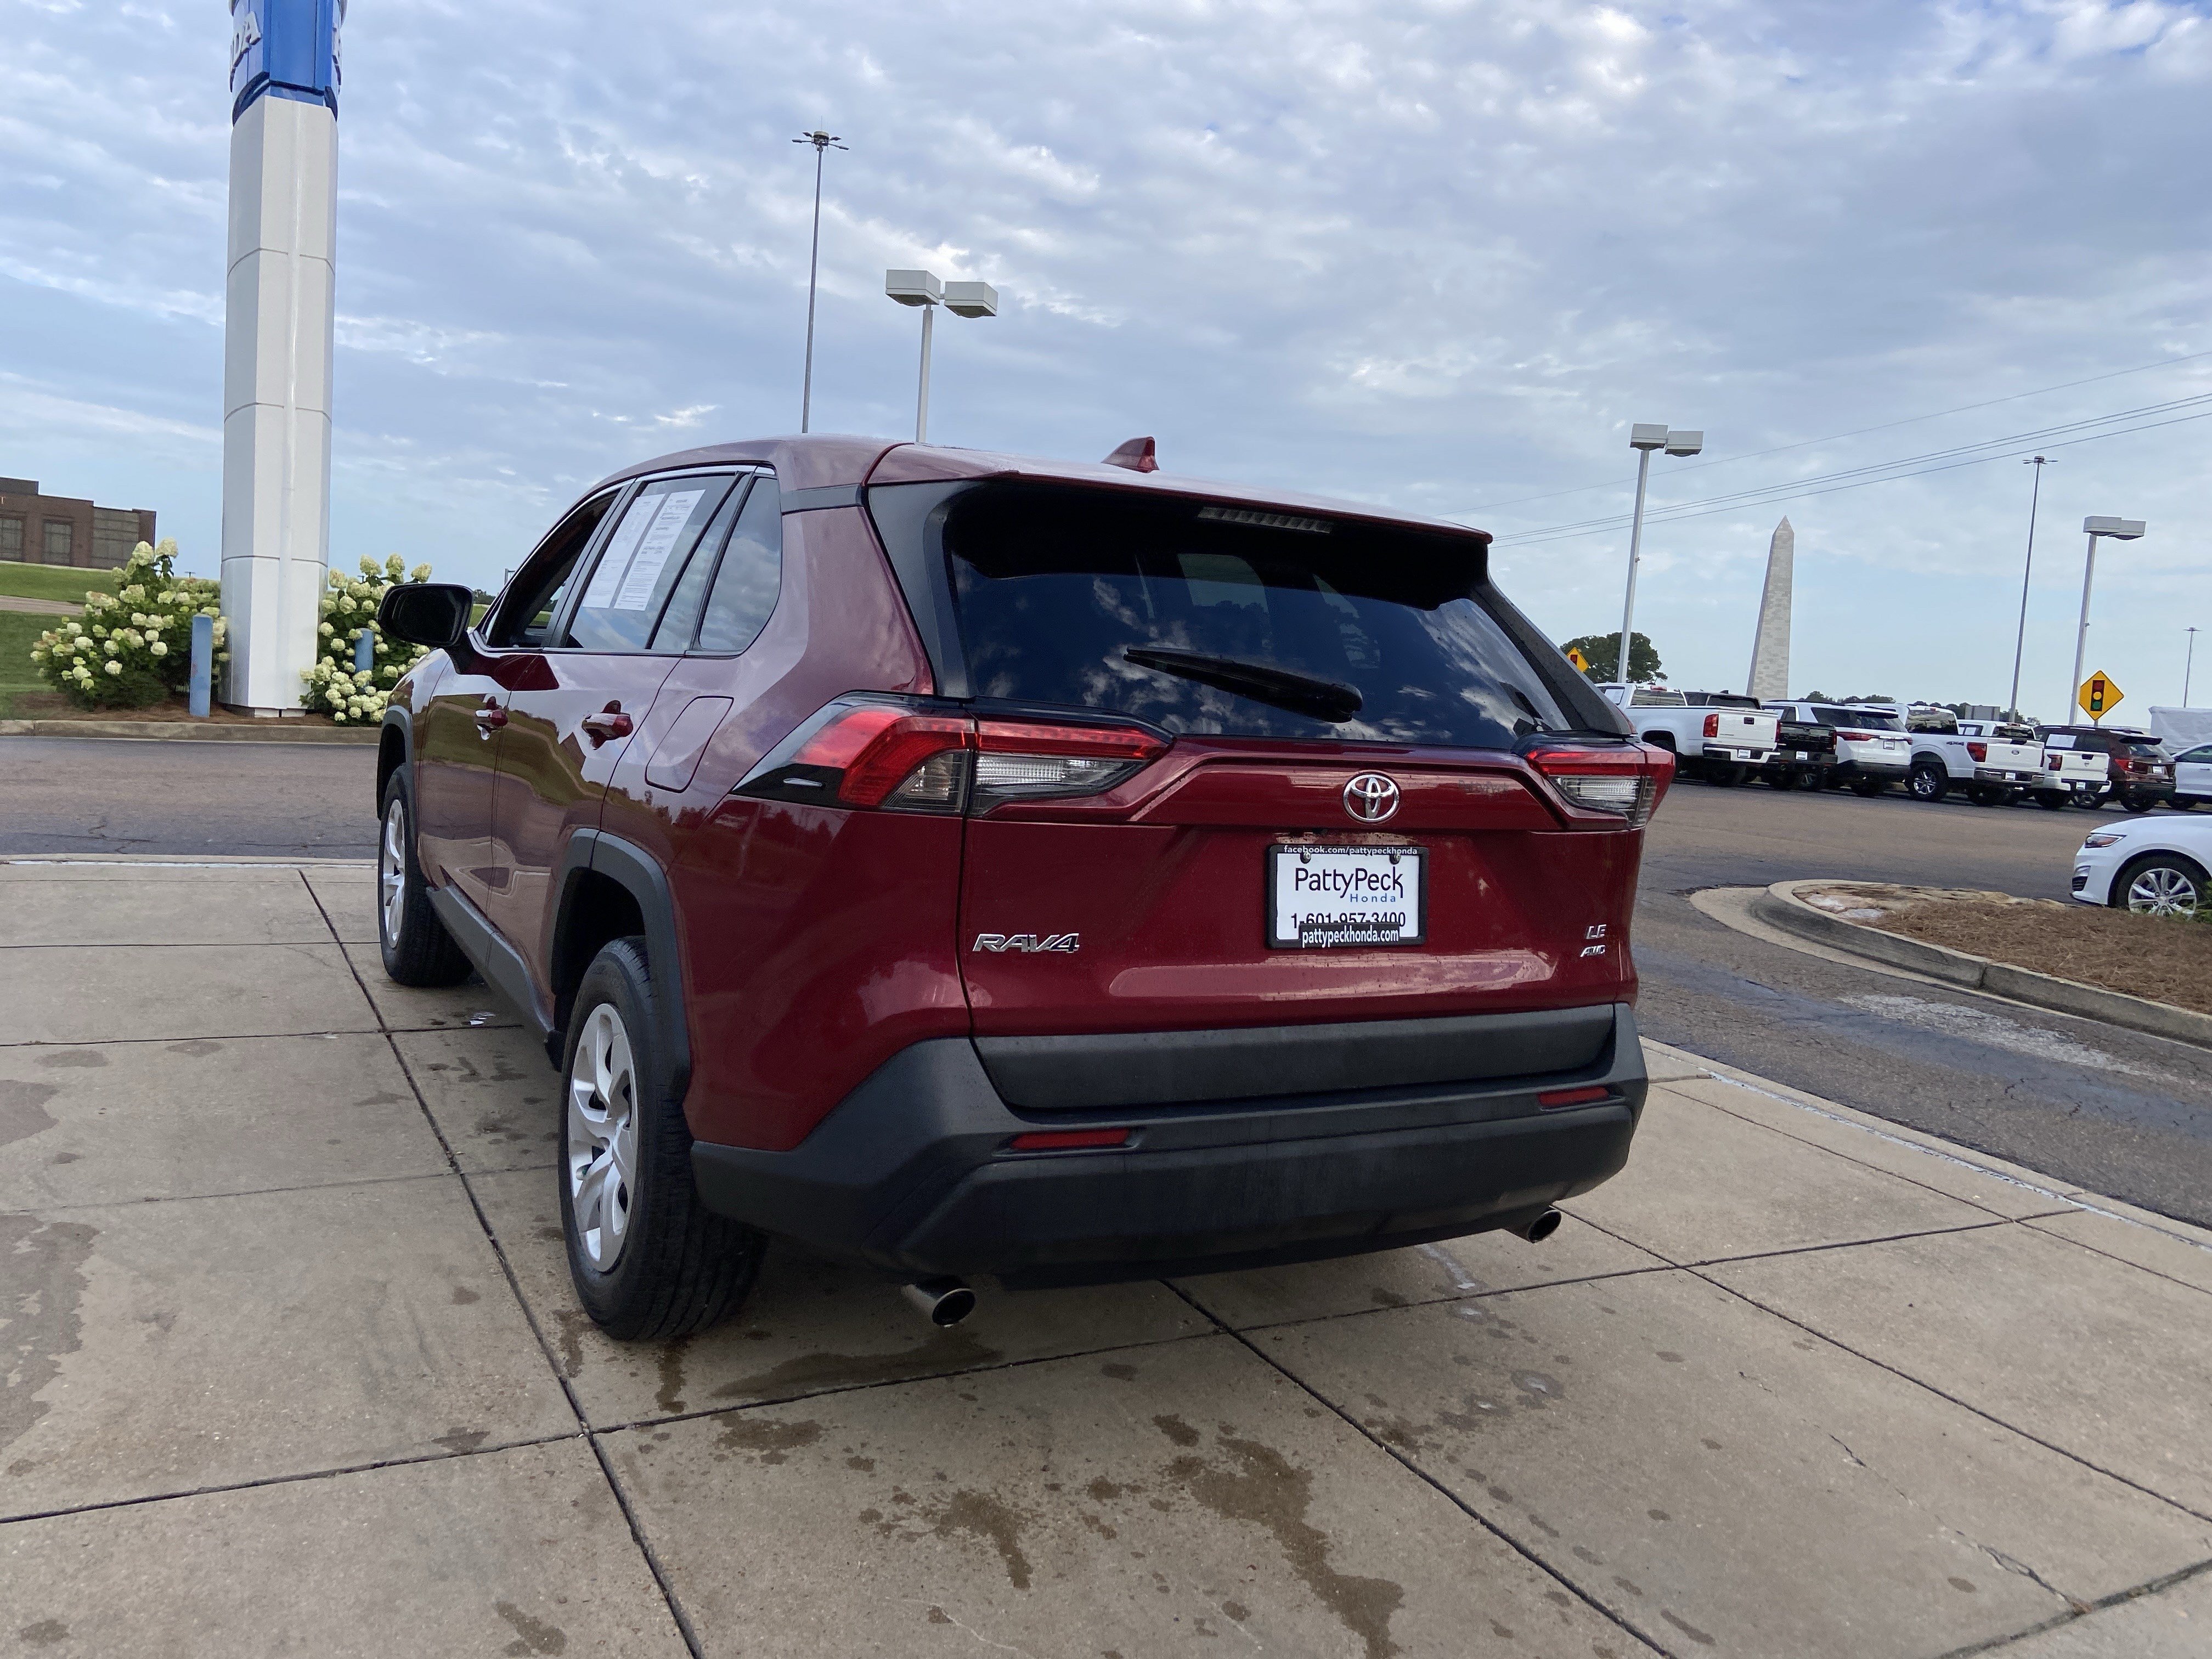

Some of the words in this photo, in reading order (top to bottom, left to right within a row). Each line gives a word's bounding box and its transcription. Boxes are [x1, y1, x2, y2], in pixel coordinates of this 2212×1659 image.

[1284, 845, 1418, 856] facebook.com/pattypeckhonda
[1295, 866, 1403, 898] PattyPeck
[1350, 893, 1396, 902] Honda
[1302, 924, 1399, 948] pattypeckhonda.com
[1585, 924, 1607, 939] LE
[972, 933, 1080, 953] RAV4
